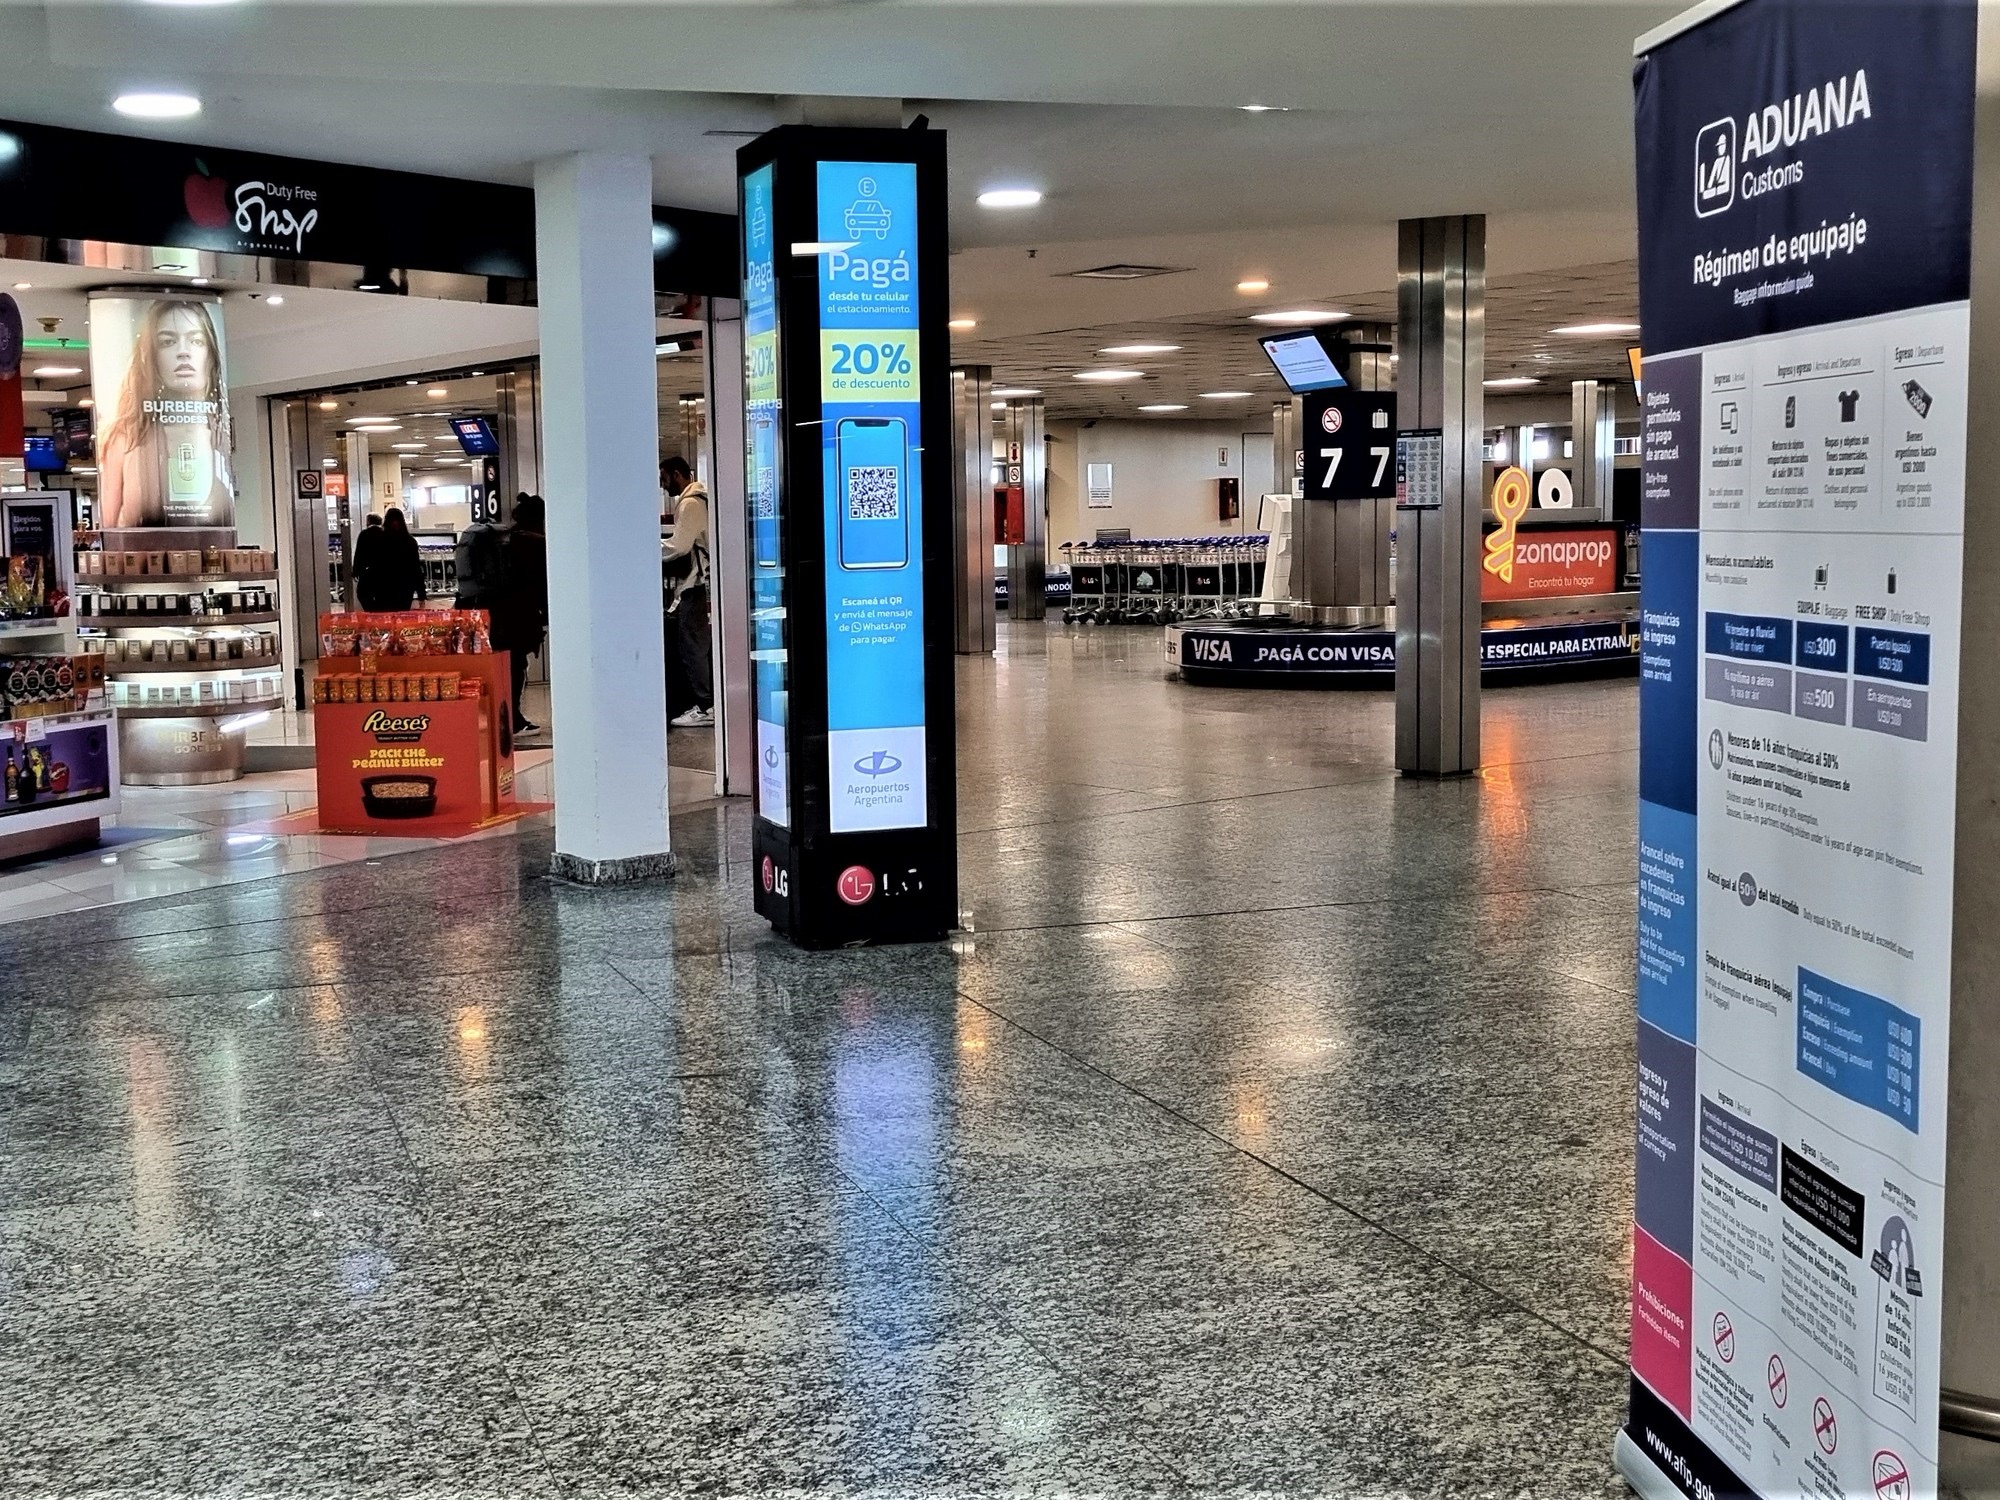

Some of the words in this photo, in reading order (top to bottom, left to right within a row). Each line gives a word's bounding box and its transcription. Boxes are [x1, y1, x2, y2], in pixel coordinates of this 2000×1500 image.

[1741, 69, 1871, 163] ADUANA
[1741, 160, 1803, 200] Customs
[267, 182, 292, 200] Duty
[295, 186, 317, 201] Free
[235, 181, 318, 254] Shop
[1693, 246, 1760, 286] Régimen
[1762, 234, 1787, 267] de
[1789, 212, 1867, 264] equipaje
[828, 250, 911, 289] Pagá
[828, 291, 859, 301] desde
[861, 292, 872, 301] tu
[874, 292, 910, 301] celular
[1757, 277, 1795, 299] information
[827, 304, 836, 314] el
[831, 343, 911, 375] 20%
[832, 378, 847, 389] de
[850, 378, 910, 389] descuento
[143, 400, 218, 414] BURBERRY
[160, 415, 208, 424] GODDESS
[1655, 430, 1673, 445] pago
[1321, 448, 1343, 488] 7
[1370, 447, 1390, 487] 7
[474, 503, 481, 519] 5
[487, 490, 498, 514] 6
[13, 514, 41, 527] Elegidos
[13, 525, 28, 534] para
[1516, 541, 1611, 568] zonaprop
[1048, 583, 1059, 591] NO
[1528, 577, 1563, 588] Encontrá
[1564, 577, 1572, 587] tu
[1573, 576, 1595, 588] hogar
[842, 596, 878, 605] Escaneá
[880, 597, 888, 605] el
[889, 596, 903, 606] QR
[834, 612, 840, 620] y
[841, 609, 865, 619] enviá
[867, 609, 876, 619] el
[877, 609, 913, 620] mensaje
[1643, 609, 1680, 628] Franquicias
[839, 621, 850, 631] de
[863, 621, 907, 632] WhatsApp
[850, 636, 870, 645] para
[1650, 628, 1676, 646] ingreso
[1816, 636, 1837, 656] 300
[1191, 638, 1232, 662] VISA
[1256, 645, 1304, 662] PAGÁ
[1307, 647, 1347, 661] CON
[1350, 646, 1395, 661] VISA
[1487, 641, 1547, 659] ESPECIAL
[1549, 639, 1580, 655] PARA
[1815, 688, 1835, 709] 500
[364, 710, 430, 733] Reese's
[1751, 736, 1760, 750] de
[1763, 737, 1771, 752] 16
[1823, 752, 1839, 769] 50%
[352, 758, 399, 769] Peanut
[401, 757, 445, 768] Butter
[847, 783, 910, 795] Aeropuertos
[854, 795, 903, 807] Argentina
[1664, 852, 1684, 869] sobre
[774, 865, 789, 898] LG
[1640, 861, 1674, 884] excedentes
[1758, 887, 1768, 902] del
[1648, 895, 1671, 919] ingreso
[1754, 973, 1771, 990] aérea
[1639, 1060, 1662, 1087] Ingreso
[1662, 1078, 1668, 1092] y
[1638, 1081, 1660, 1103] egreso
[1660, 1093, 1670, 1109] de
[1638, 1097, 1662, 1121] valores
[1746, 1134, 1754, 1145] de
[1730, 1138, 1744, 1155] USD
[1744, 1146, 1768, 1167] 10.000
[1830, 1190, 1838, 1201] de
[1816, 1194, 1829, 1212] USD
[1830, 1204, 1851, 1228] 10.000
[1638, 1281, 1685, 1330] Prohibiciones
[1663, 1326, 1681, 1349] items
[1885, 1332, 1898, 1349] USD
[1880, 1349, 1902, 1369] Children
[1878, 1362, 1885, 1375] 16
[1886, 1369, 1902, 1384] years
[1885, 1380, 1898, 1396] USD
